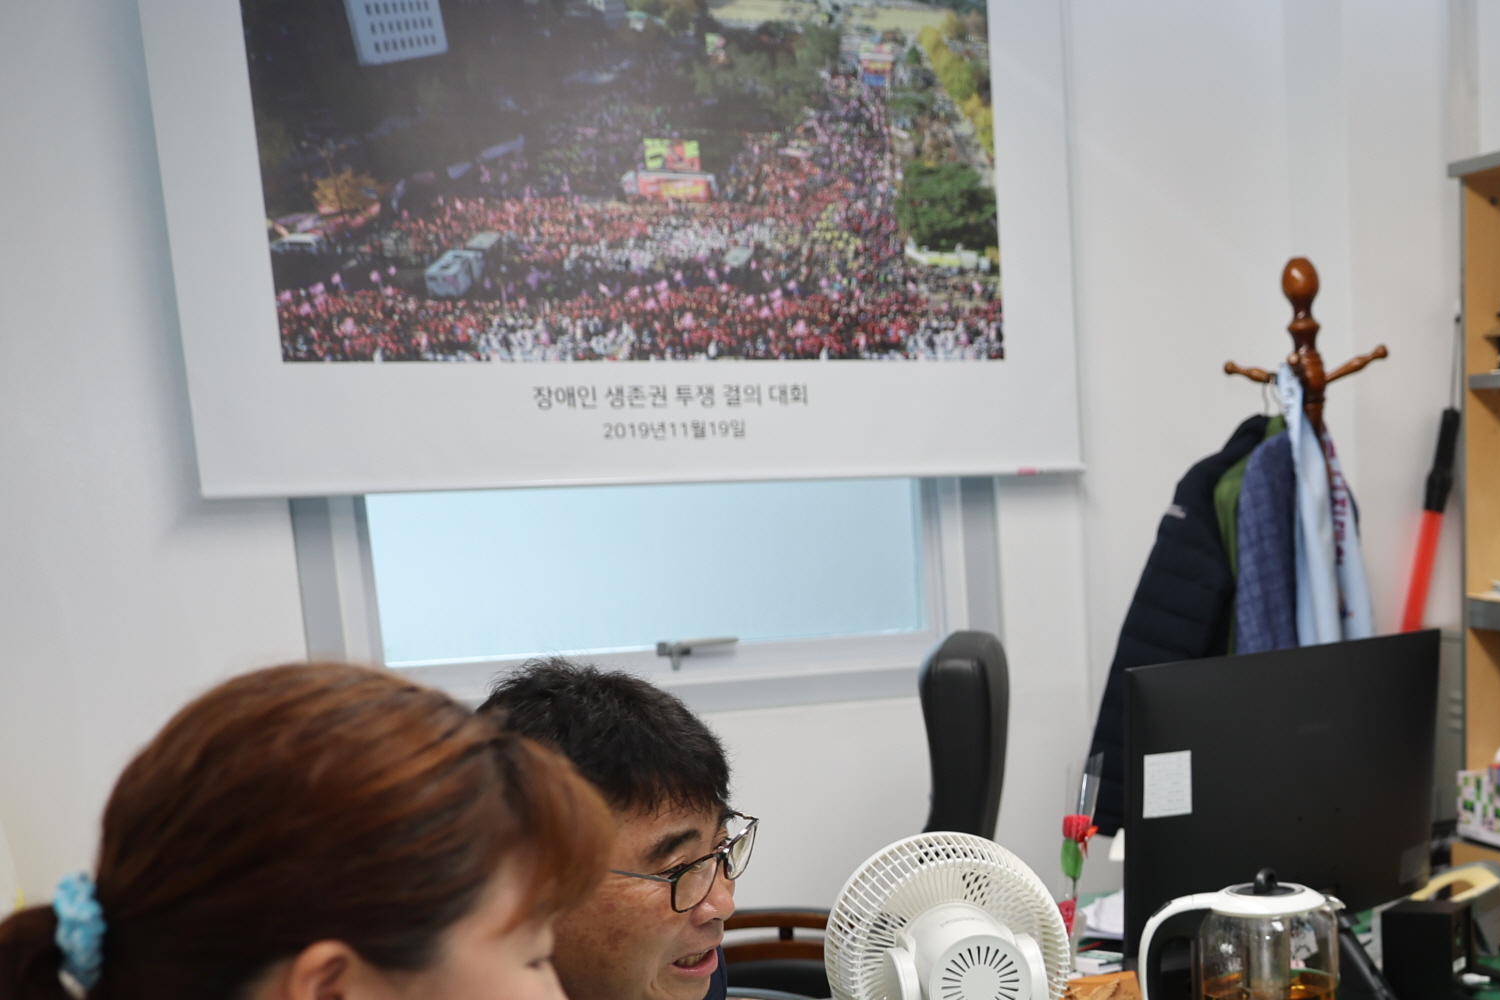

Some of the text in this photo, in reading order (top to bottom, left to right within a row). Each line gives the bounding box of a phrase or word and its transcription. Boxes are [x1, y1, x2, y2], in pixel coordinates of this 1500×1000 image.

[532, 382, 808, 410] 장애인 생존권 투쟁 결의 대회
[603, 418, 746, 440] 2019년11월19일
